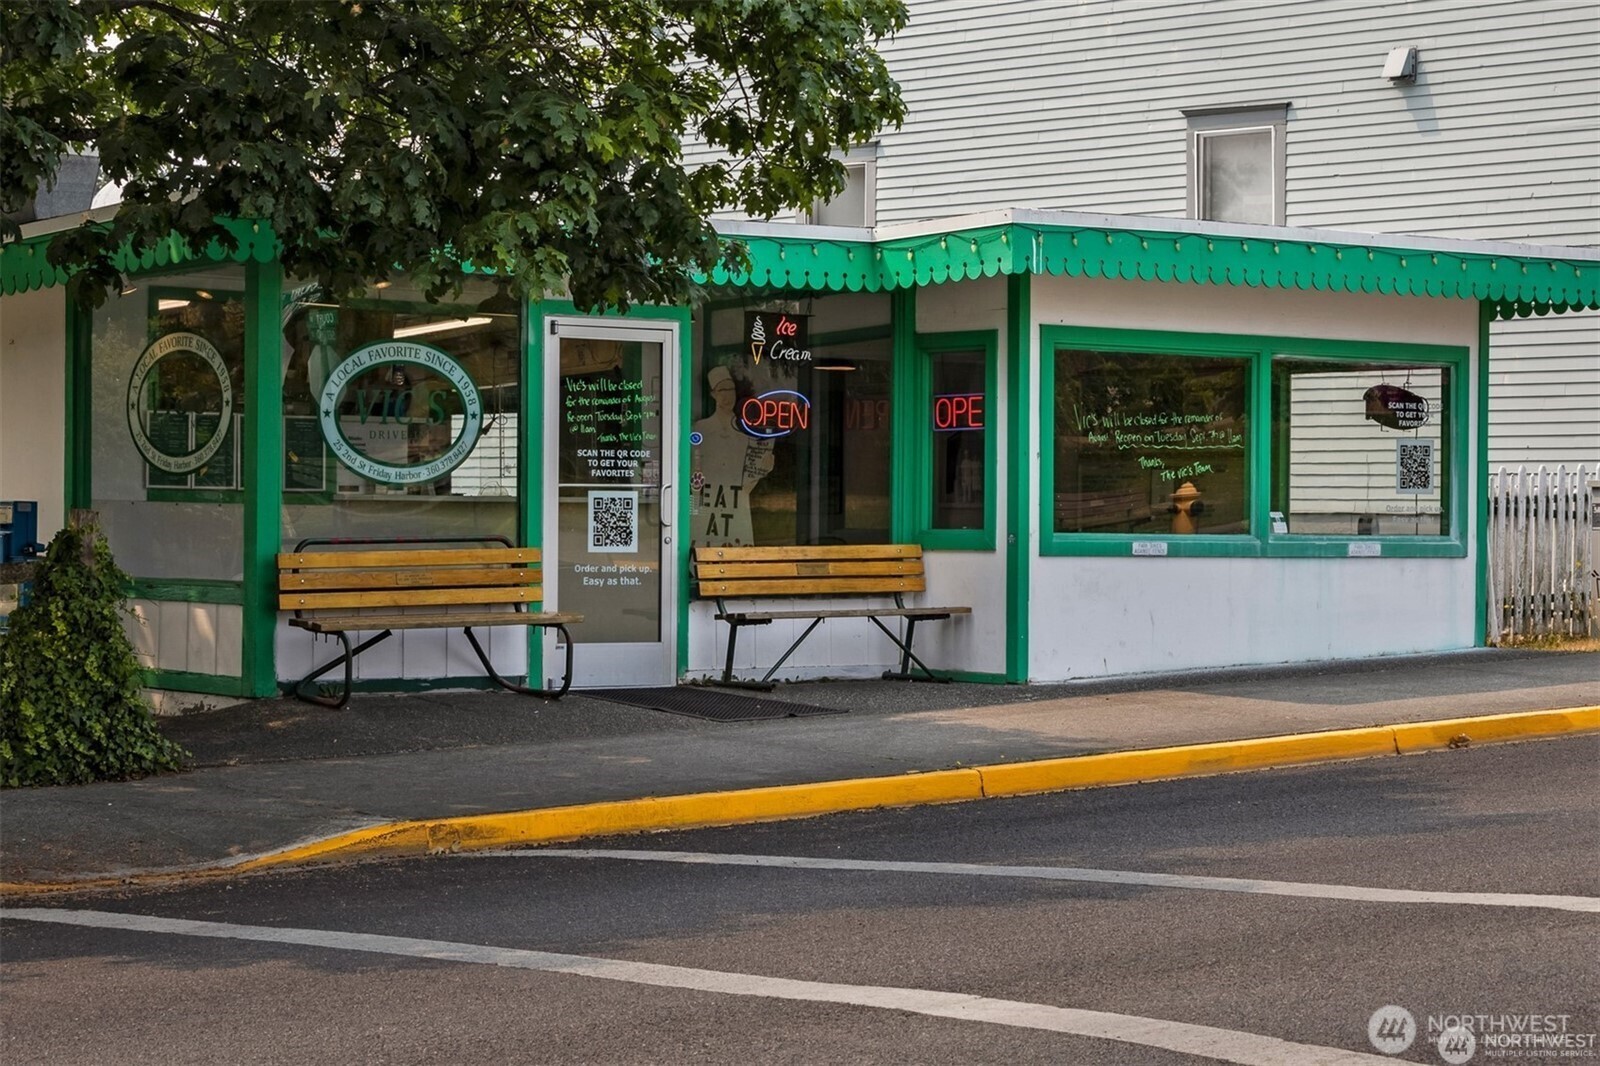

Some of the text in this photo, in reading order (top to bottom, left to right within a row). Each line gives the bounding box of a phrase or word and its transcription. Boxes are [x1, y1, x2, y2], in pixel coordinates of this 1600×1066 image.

[776, 316, 797, 336] Ice
[158, 335, 193, 353] FAVORITE
[195, 338, 217, 364] SINCE
[770, 340, 812, 361] Cream
[135, 350, 159, 381] LOCAL
[325, 346, 477, 406] A LOCAL FAVORITE SINCE 1958
[588, 377, 607, 392] will
[607, 379, 617, 391] be
[618, 380, 644, 391] closed
[132, 385, 139, 395] A
[356, 389, 447, 426] VICS
[565, 395, 577, 408] for
[578, 396, 590, 406] the
[622, 395, 631, 404] of
[1405, 402, 1417, 410] THE
[742, 398, 809, 430] OPEN
[935, 396, 983, 428] OPE
[1102, 411, 1120, 428] will
[1123, 412, 1133, 427] be
[1134, 412, 1157, 426] closed
[1158, 412, 1168, 425] for
[1171, 412, 1183, 425] the
[1215, 412, 1223, 421] of
[1144, 435, 1155, 443] on
[156, 454, 173, 470] Friday
[173, 460, 192, 469] Harbor
[333, 438, 343, 452] 25
[342, 448, 357, 466] 2nd
[357, 460, 366, 472] St
[367, 464, 392, 481] Friday
[394, 470, 422, 480] Harbor
[577, 449, 598, 457] SCAN
[616, 450, 628, 458] QR
[629, 450, 651, 458] CODE
[587, 459, 599, 467] TO
[591, 469, 635, 477] FAVORITES
[699, 483, 743, 509] EAT
[706, 512, 734, 537] AT
[574, 564, 652, 574] Order and pick up.
[583, 577, 605, 587] Easy
[620, 577, 642, 586] that.
